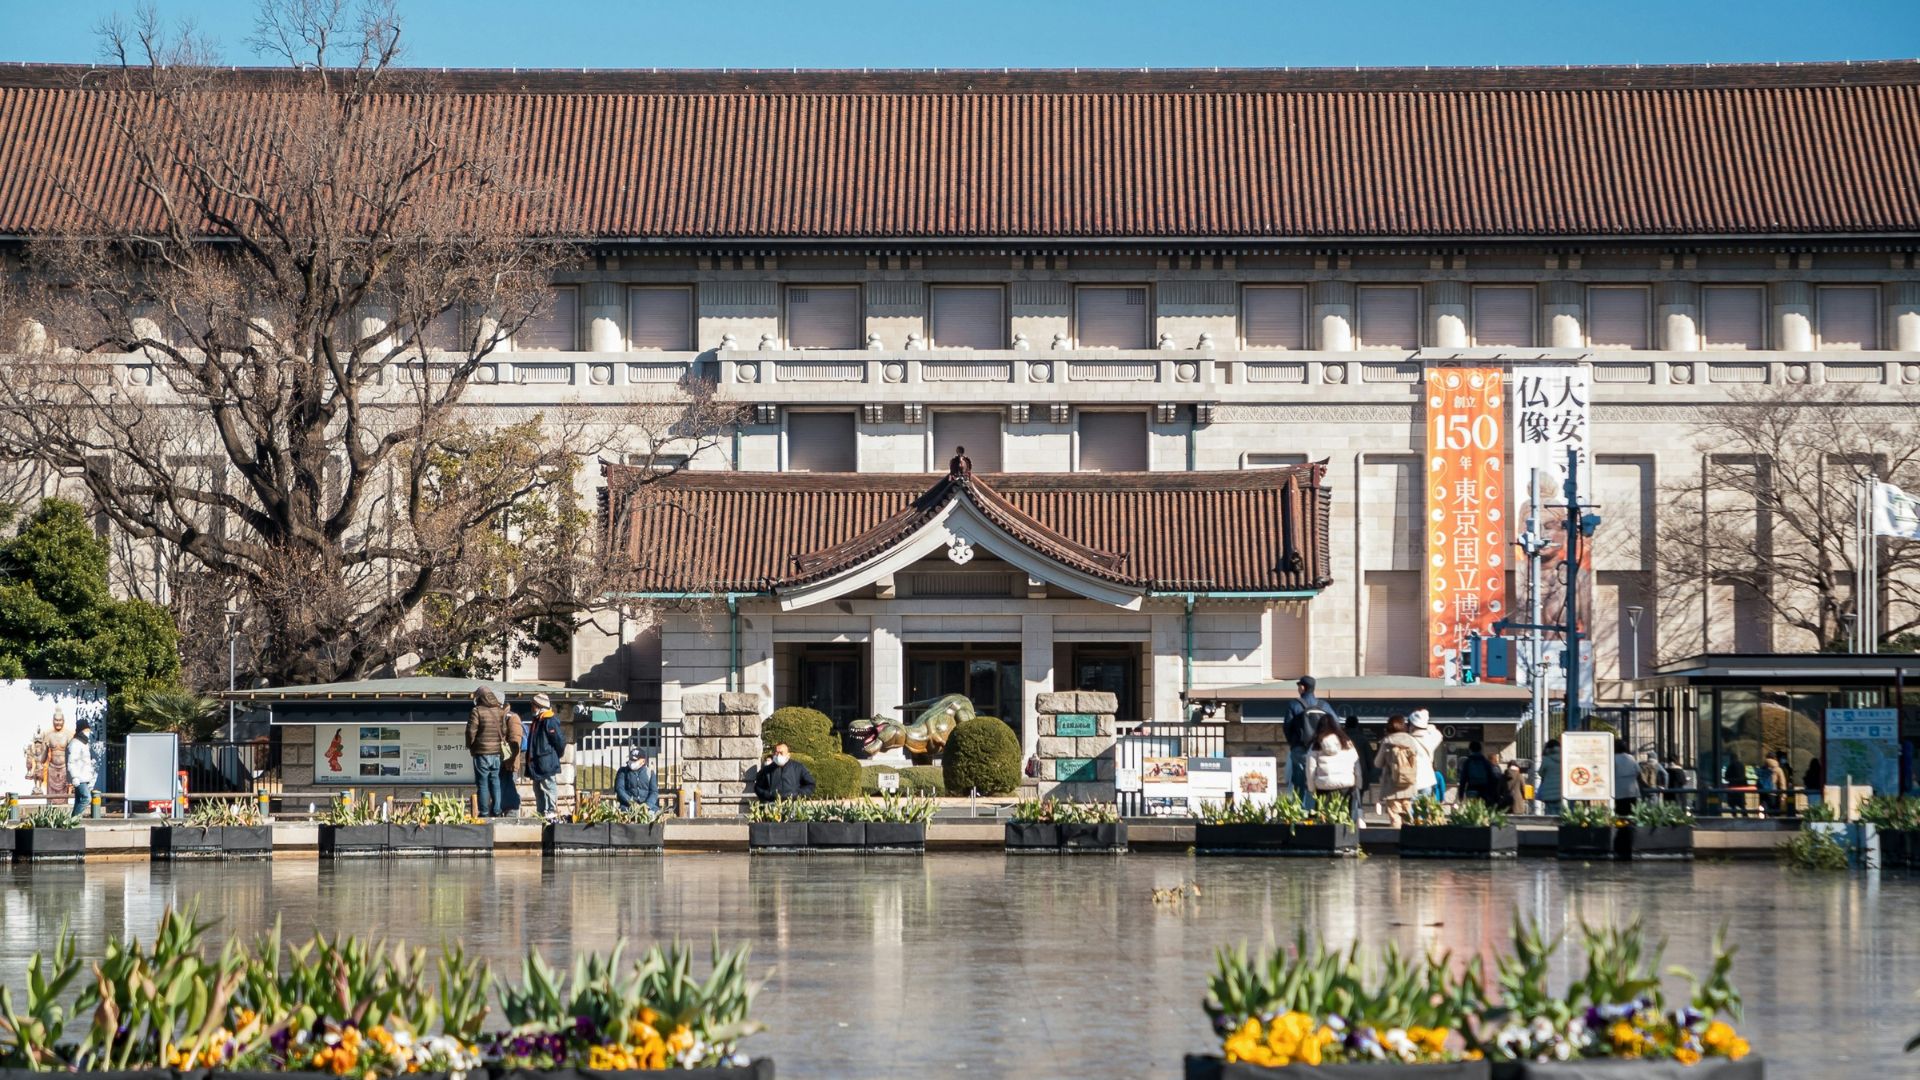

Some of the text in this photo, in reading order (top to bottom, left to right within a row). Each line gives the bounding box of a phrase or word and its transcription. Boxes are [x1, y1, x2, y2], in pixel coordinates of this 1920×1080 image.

[1453, 395, 1476, 408] 創立
[1516, 376, 1550, 444] 仏像
[1432, 414, 1499, 451] 150
[1458, 456, 1473, 470] 年
[1452, 477, 1481, 681] 東京国立博物
